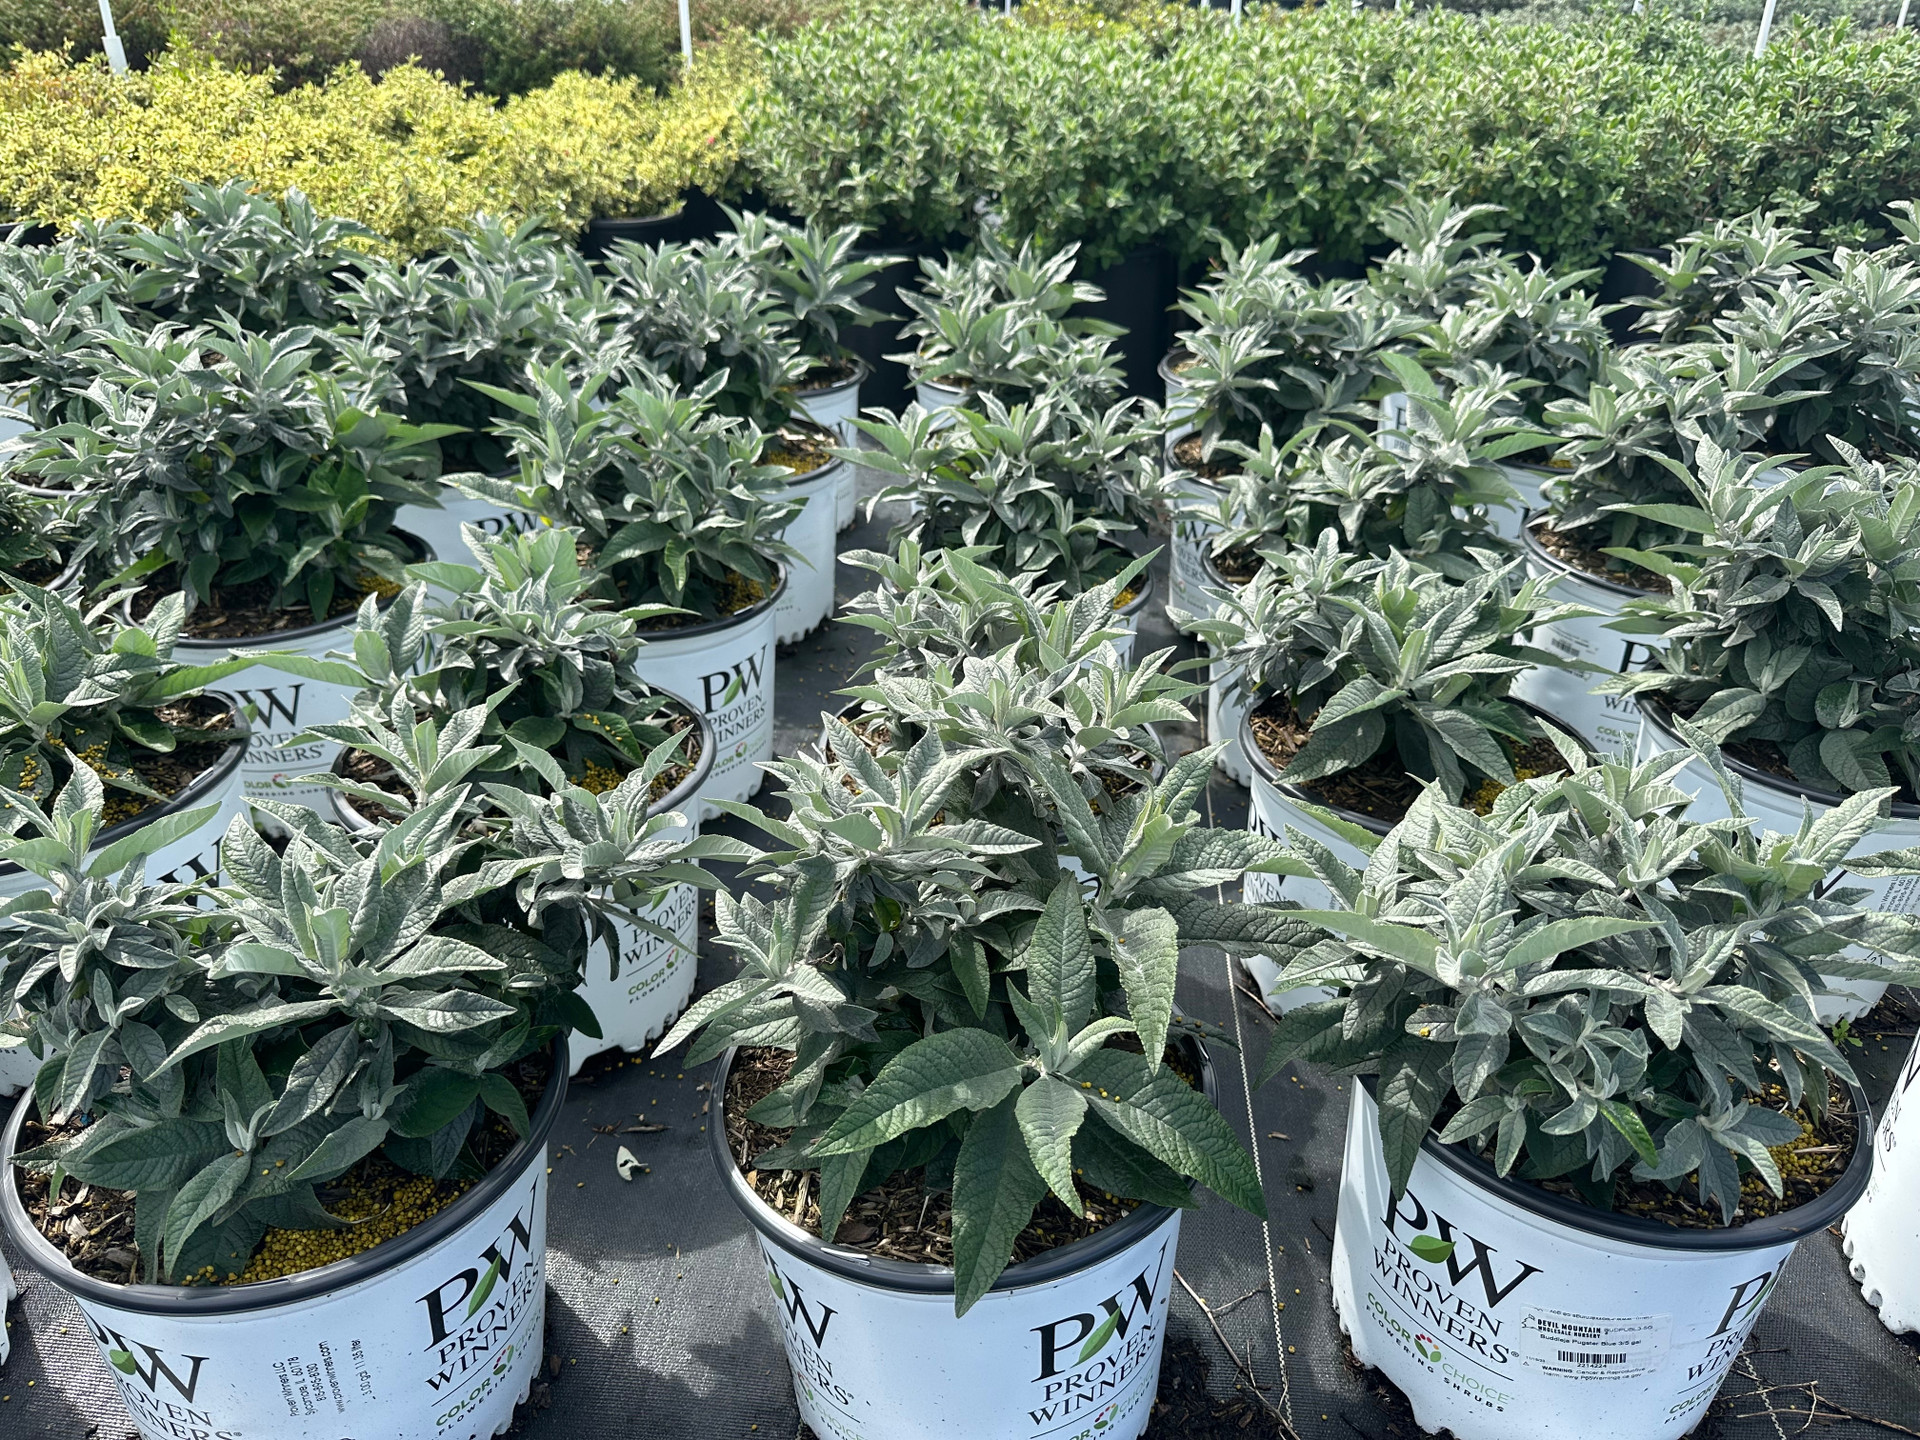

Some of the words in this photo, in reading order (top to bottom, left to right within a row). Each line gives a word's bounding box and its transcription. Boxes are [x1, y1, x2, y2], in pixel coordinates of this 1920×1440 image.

[698, 643, 767, 714] PW
[628, 968, 665, 995] COLOR
[416, 1172, 539, 1352] PW
[1380, 1184, 1544, 1309] PW
[1384, 1235, 1504, 1337] PROVEN
[438, 1251, 535, 1367] PROVEN
[1030, 1235, 1170, 1383] PW
[1043, 1311, 1156, 1402] PROVEN
[1368, 1292, 1412, 1344] COLOR
[1442, 1363, 1511, 1405] CHOICE
[1537, 1318, 1559, 1329] DEVIL
[1561, 1323, 1601, 1333] MOUNTAIN
[1538, 1325, 1571, 1336] WHOLESALE
[272, 1362, 286, 1374] LLC
[436, 1378, 490, 1426] COLOR
[1366, 1305, 1434, 1373] FLOWERING
[1443, 1377, 1505, 1412] SHRUBS
